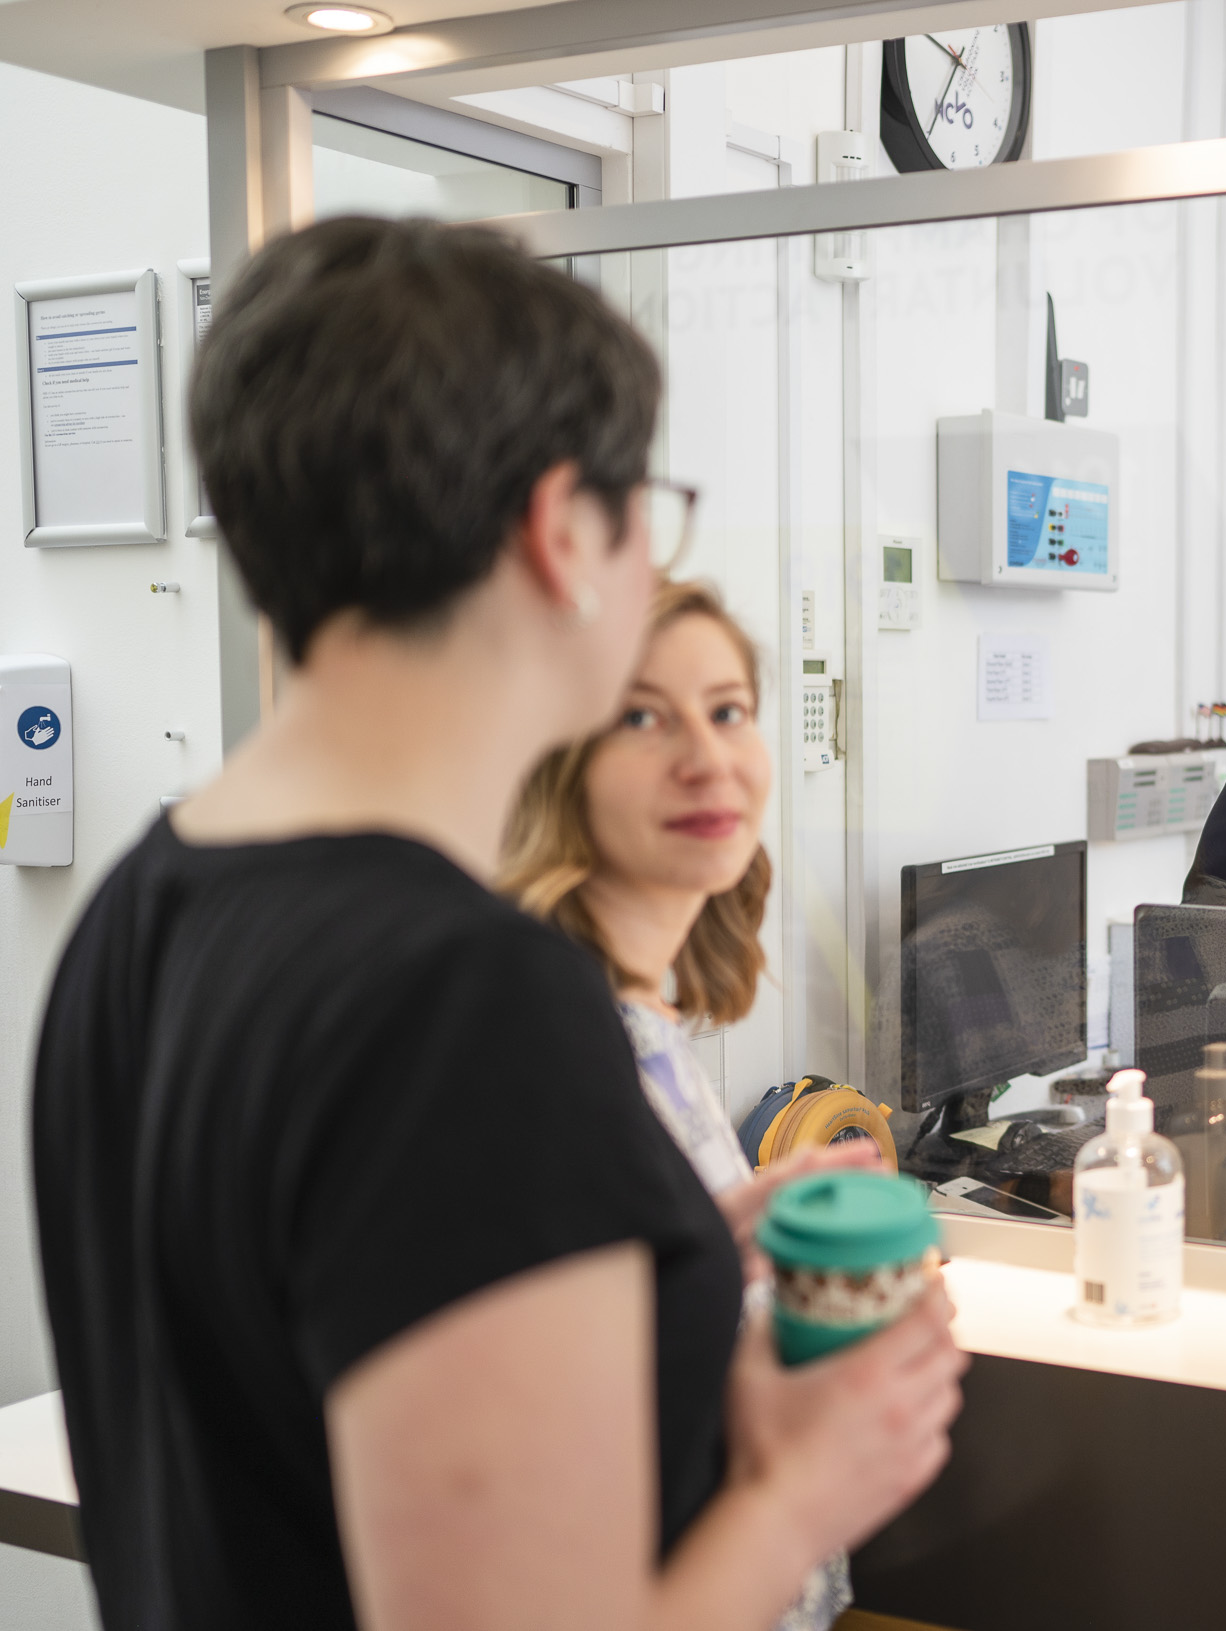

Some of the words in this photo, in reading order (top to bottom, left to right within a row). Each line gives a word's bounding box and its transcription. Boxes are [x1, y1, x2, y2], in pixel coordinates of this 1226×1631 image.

[934, 89, 974, 130] NCVO
[25, 776, 52, 786] Hand
[16, 796, 61, 808] Sanitiser
